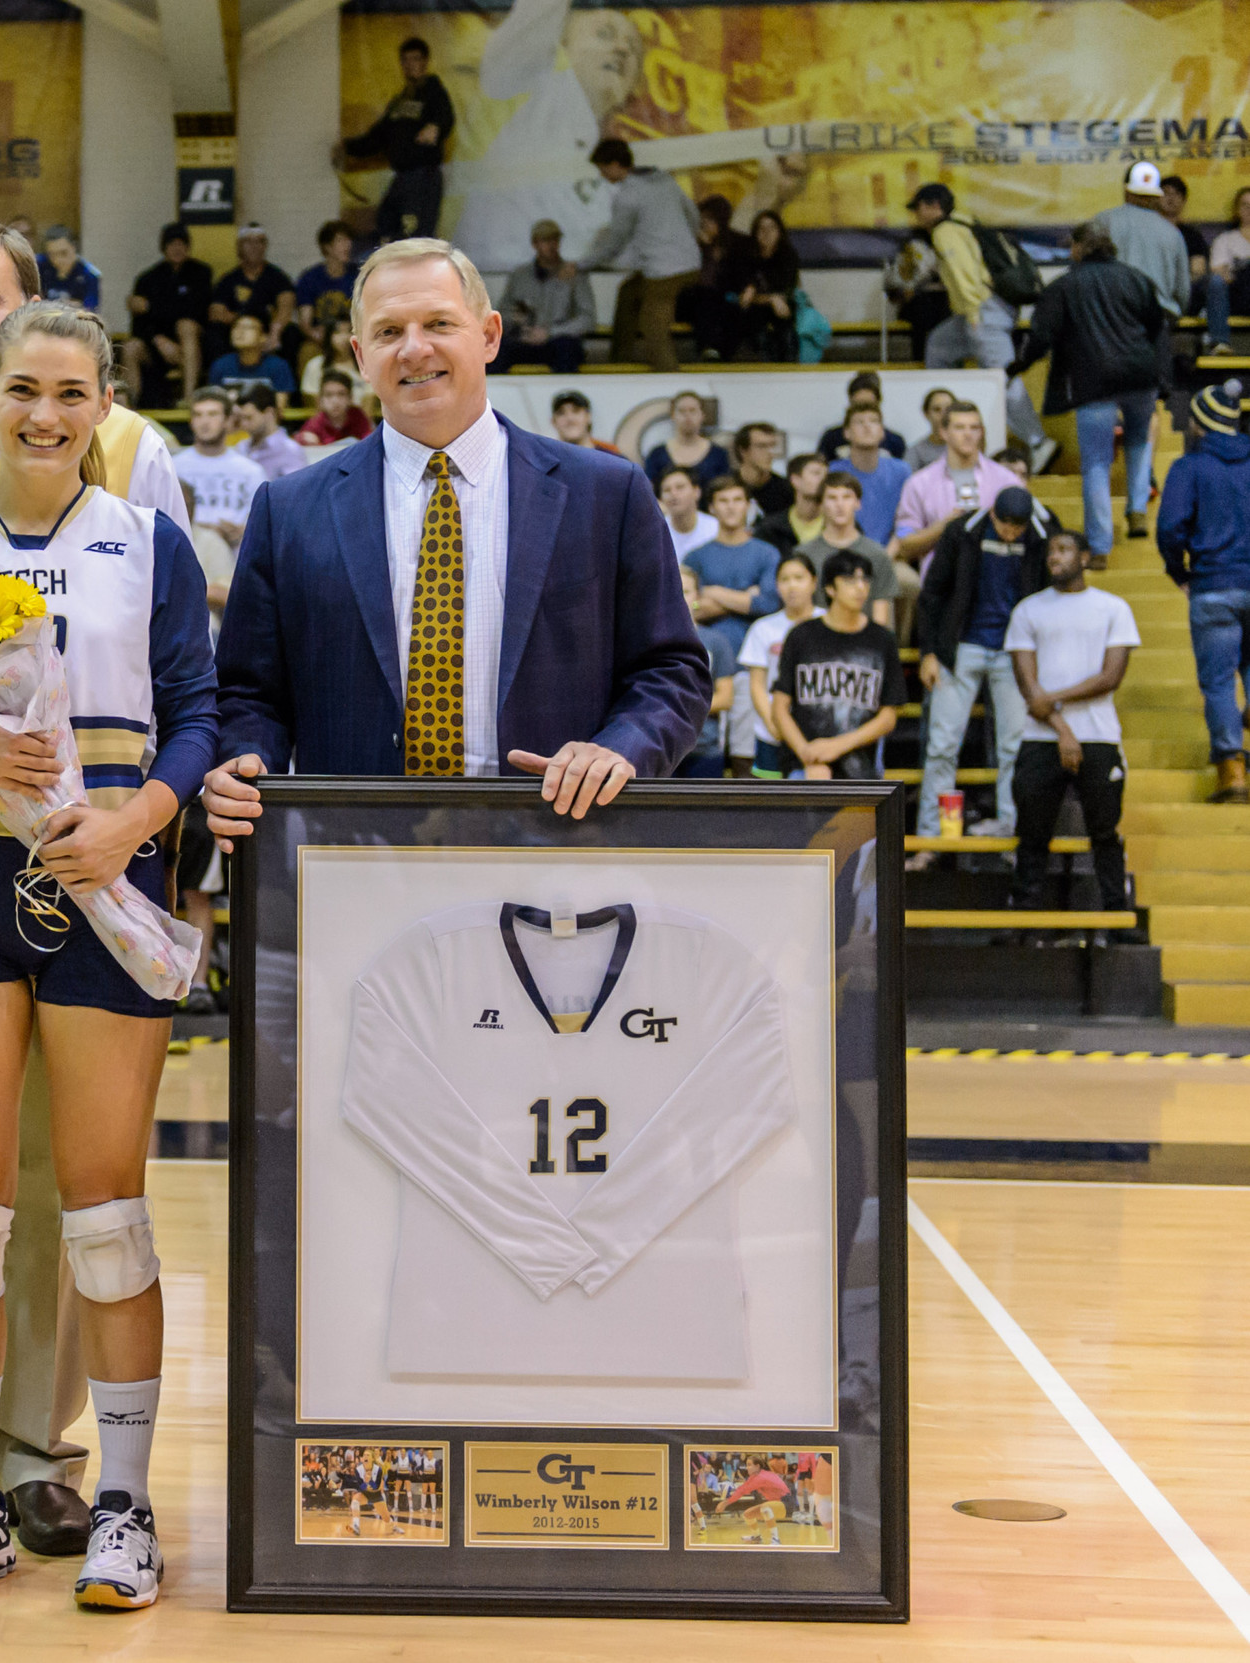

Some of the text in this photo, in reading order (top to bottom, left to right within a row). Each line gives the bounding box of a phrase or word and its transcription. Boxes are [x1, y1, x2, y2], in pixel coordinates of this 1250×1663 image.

[763, 121, 954, 151] ULRIKE
[84, 541, 128, 556] ACC
[619, 1007, 678, 1043] GT
[528, 1096, 609, 1176] 12
[537, 1453, 596, 1491] GT
[475, 1493, 658, 1512] Wimberly Wilson #12
[532, 1516, 600, 1529] 2012-2015
